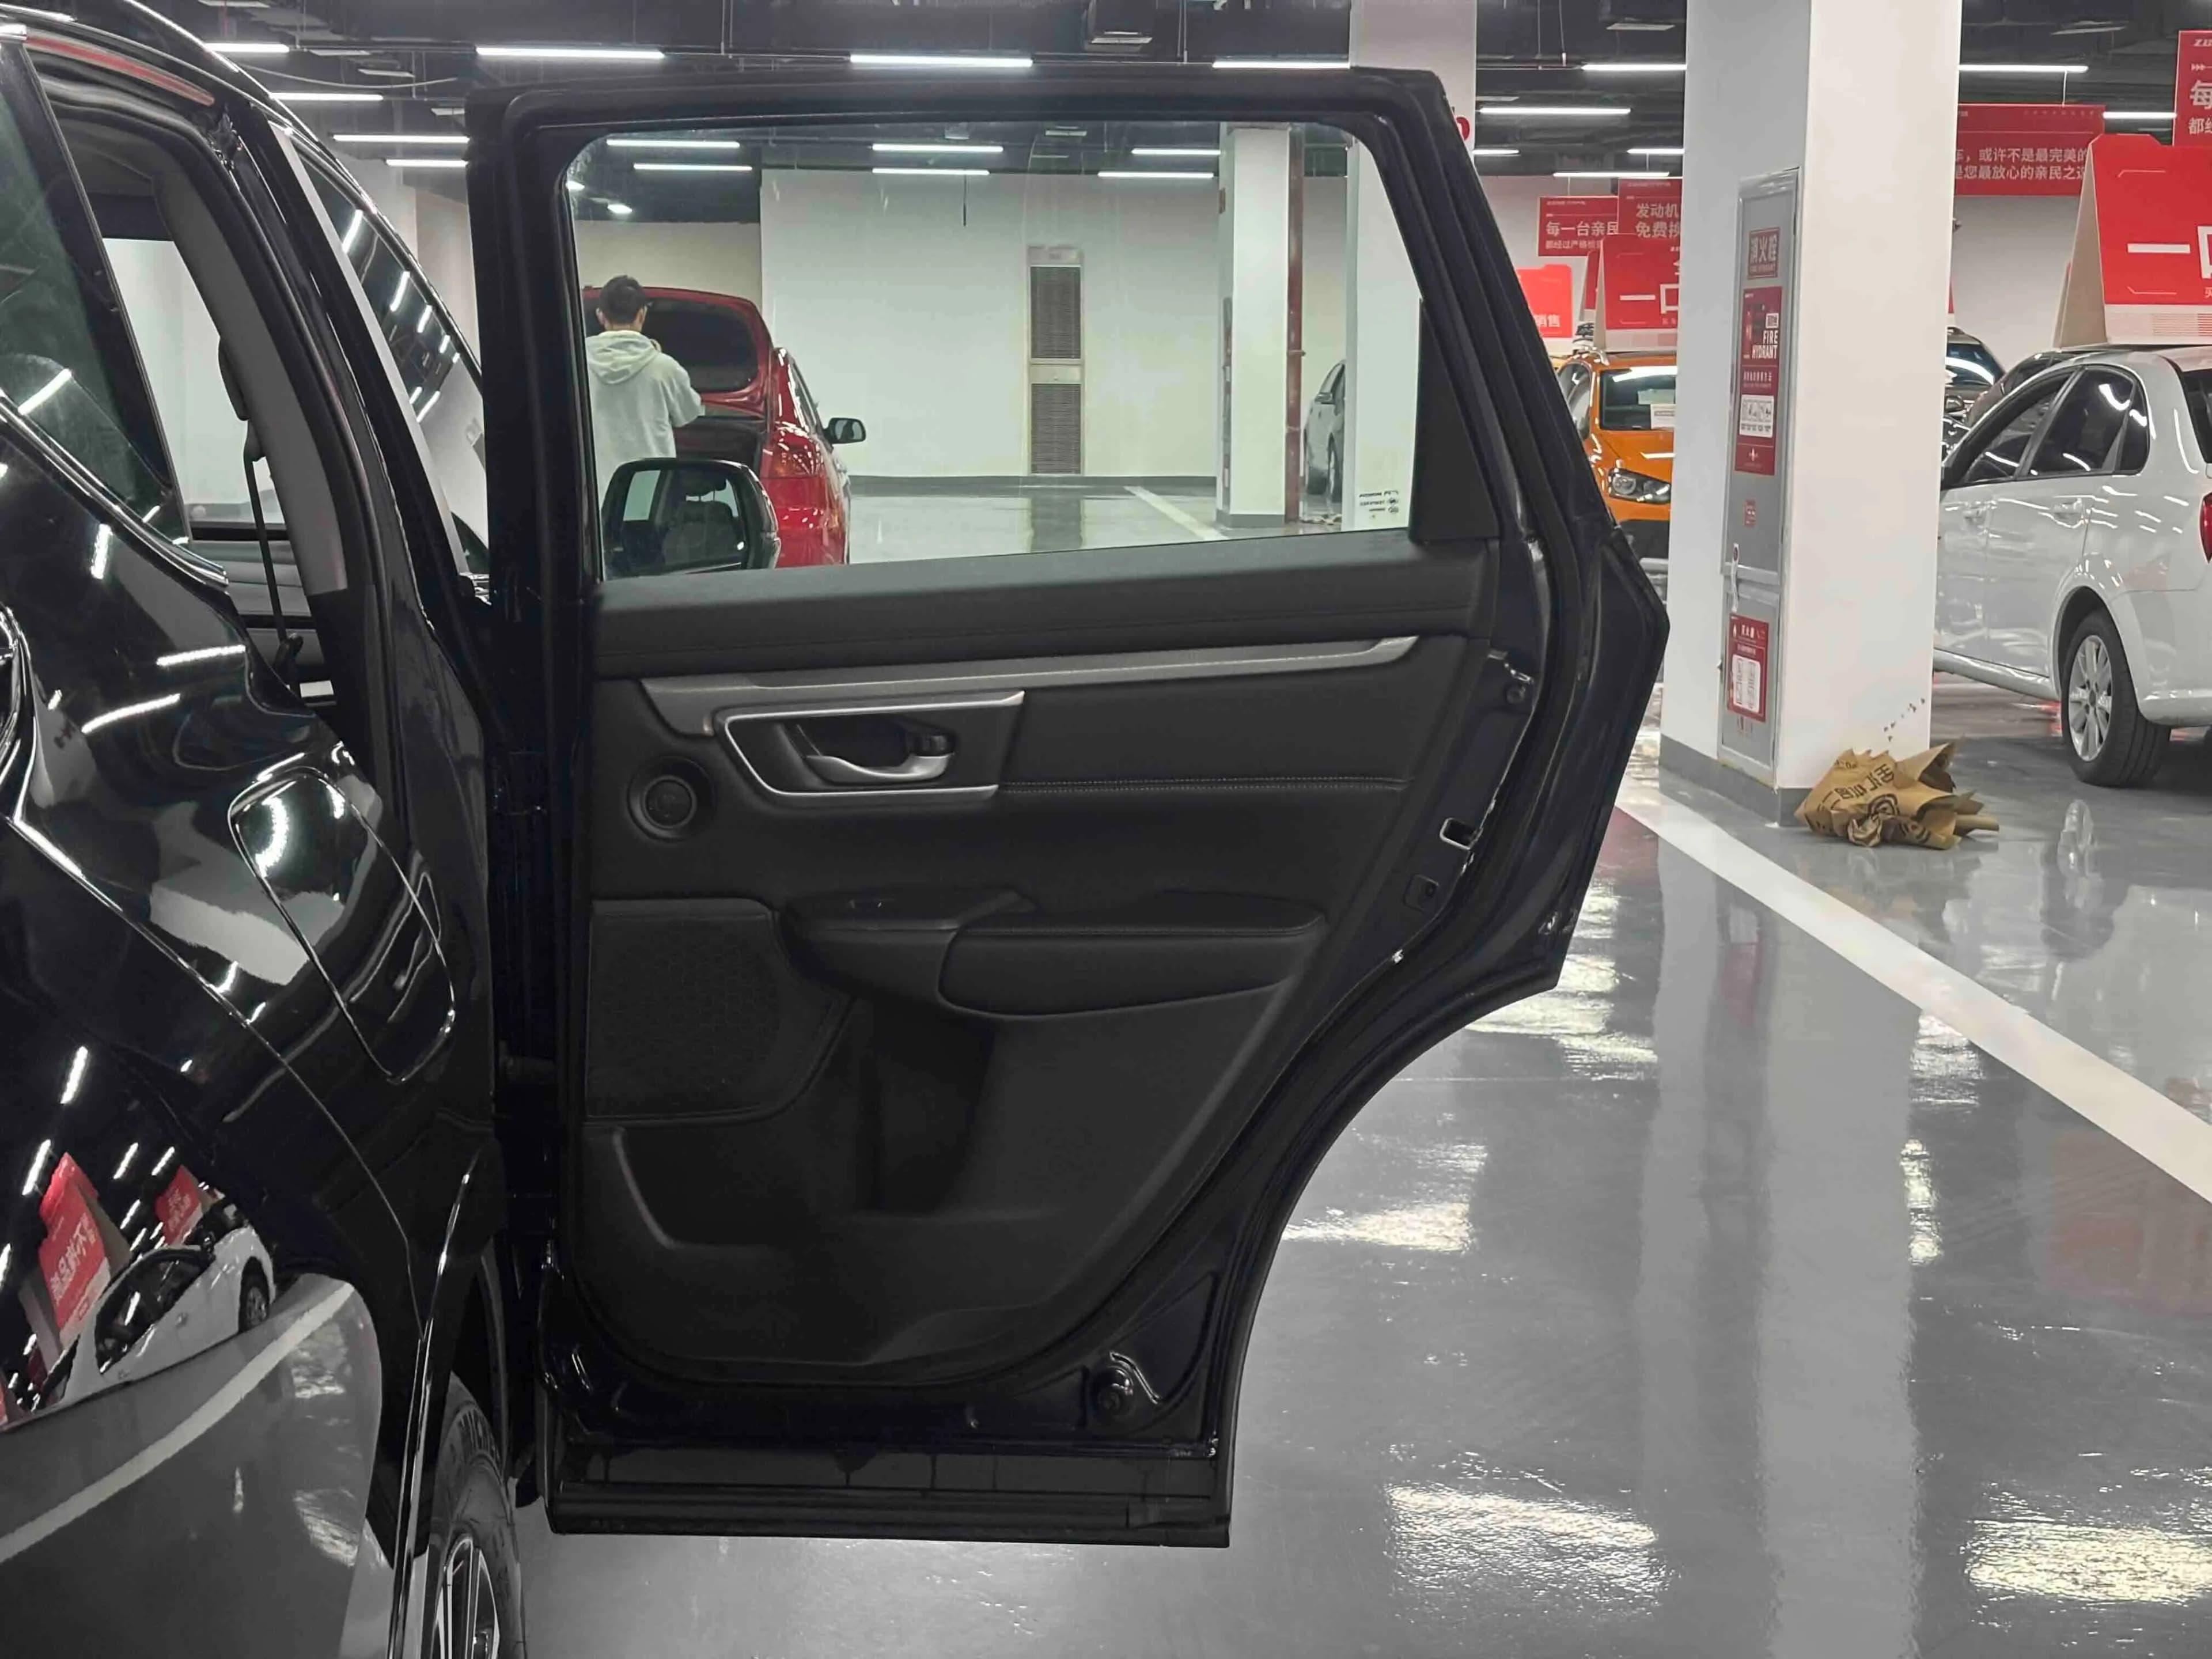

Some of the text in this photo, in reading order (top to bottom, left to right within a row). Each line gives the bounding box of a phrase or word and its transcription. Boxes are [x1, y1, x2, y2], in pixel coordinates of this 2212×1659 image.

[1636, 203, 1679, 218] 发动机
[2127, 225, 2212, 279] 一
[1763, 329, 1779, 344] FIRE
[1751, 344, 1778, 360] HYDRANT
